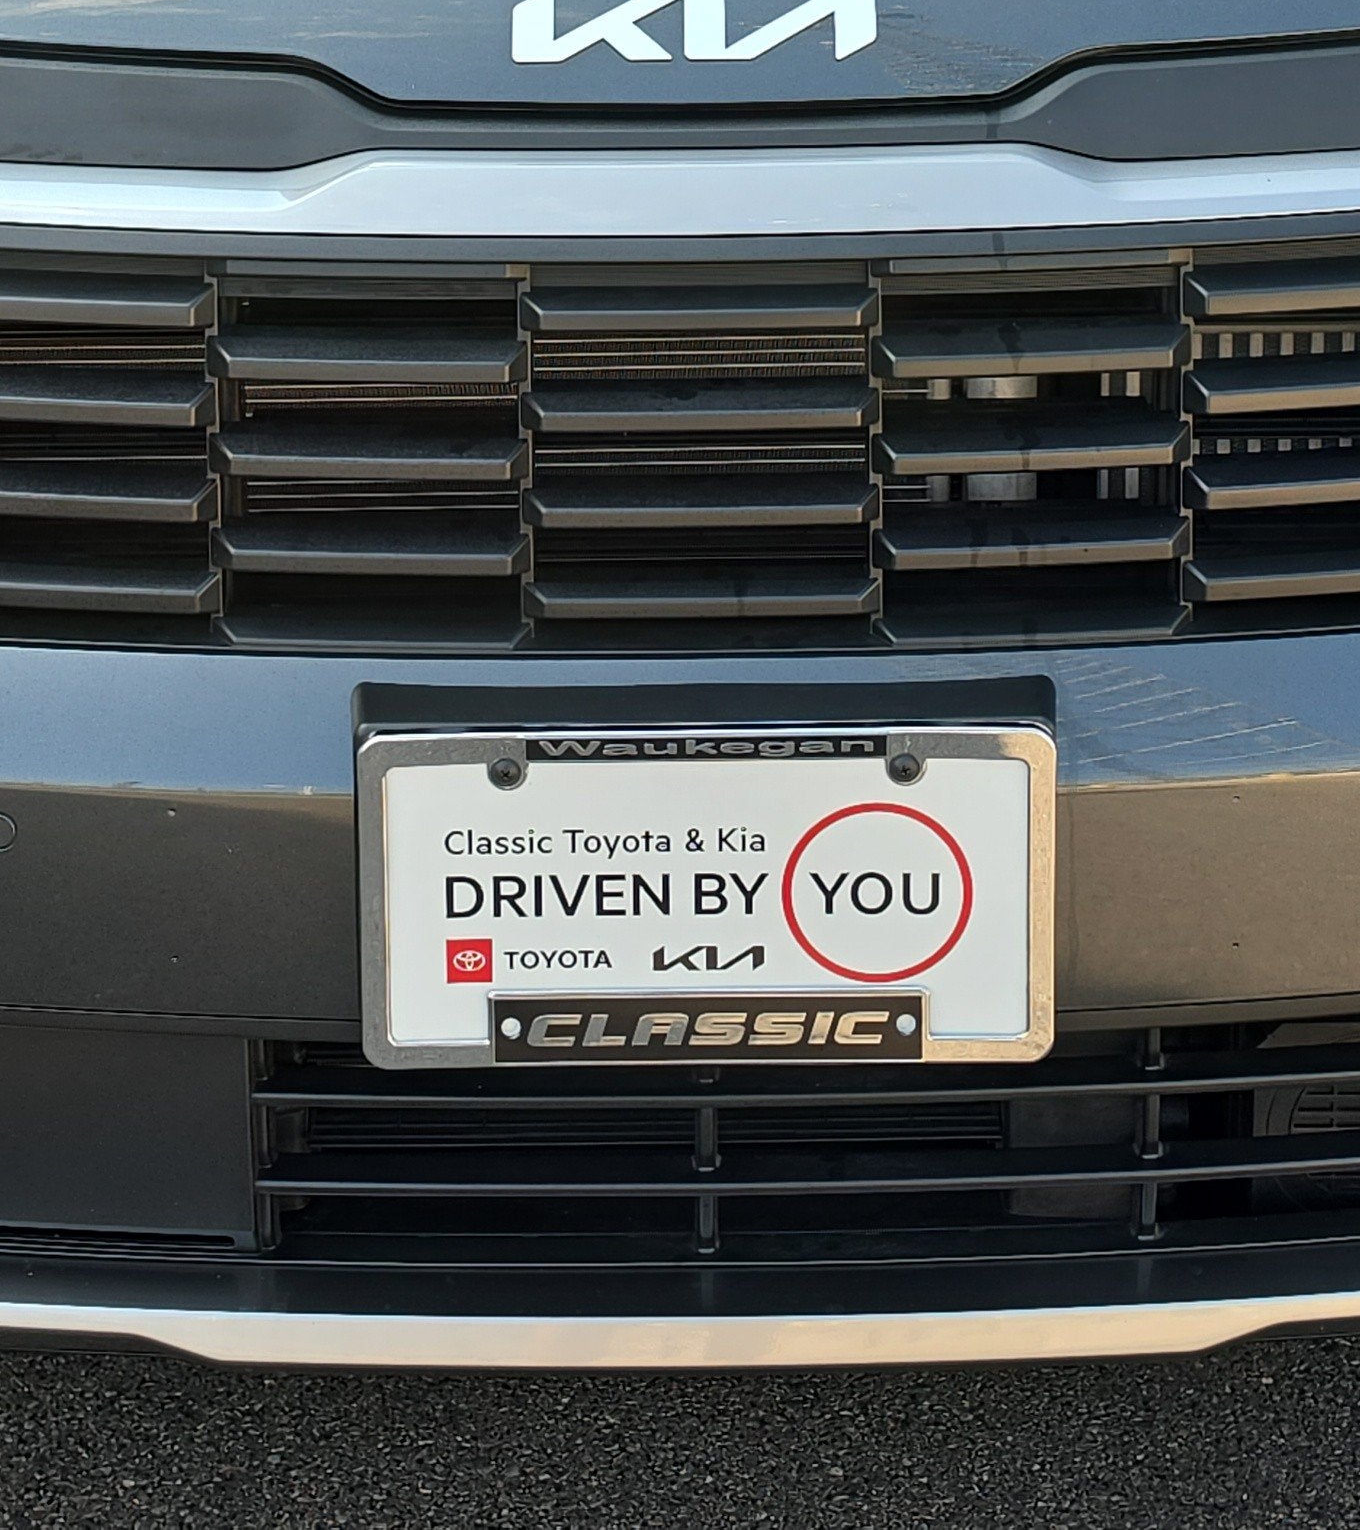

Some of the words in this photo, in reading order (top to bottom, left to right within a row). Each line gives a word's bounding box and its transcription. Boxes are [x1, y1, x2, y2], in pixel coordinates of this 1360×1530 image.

[538, 736, 874, 759] Waukegan
[444, 829, 553, 856] Classic
[562, 828, 672, 861] Toyota
[685, 828, 705, 853] &
[717, 826, 766, 852] Kia
[445, 872, 671, 919] DRIVEN
[693, 871, 769, 916] BY
[810, 871, 941, 916] YOU
[504, 949, 613, 970] TOYOTA
[651, 945, 766, 971] KIA
[526, 1009, 890, 1048] CLASSIC
